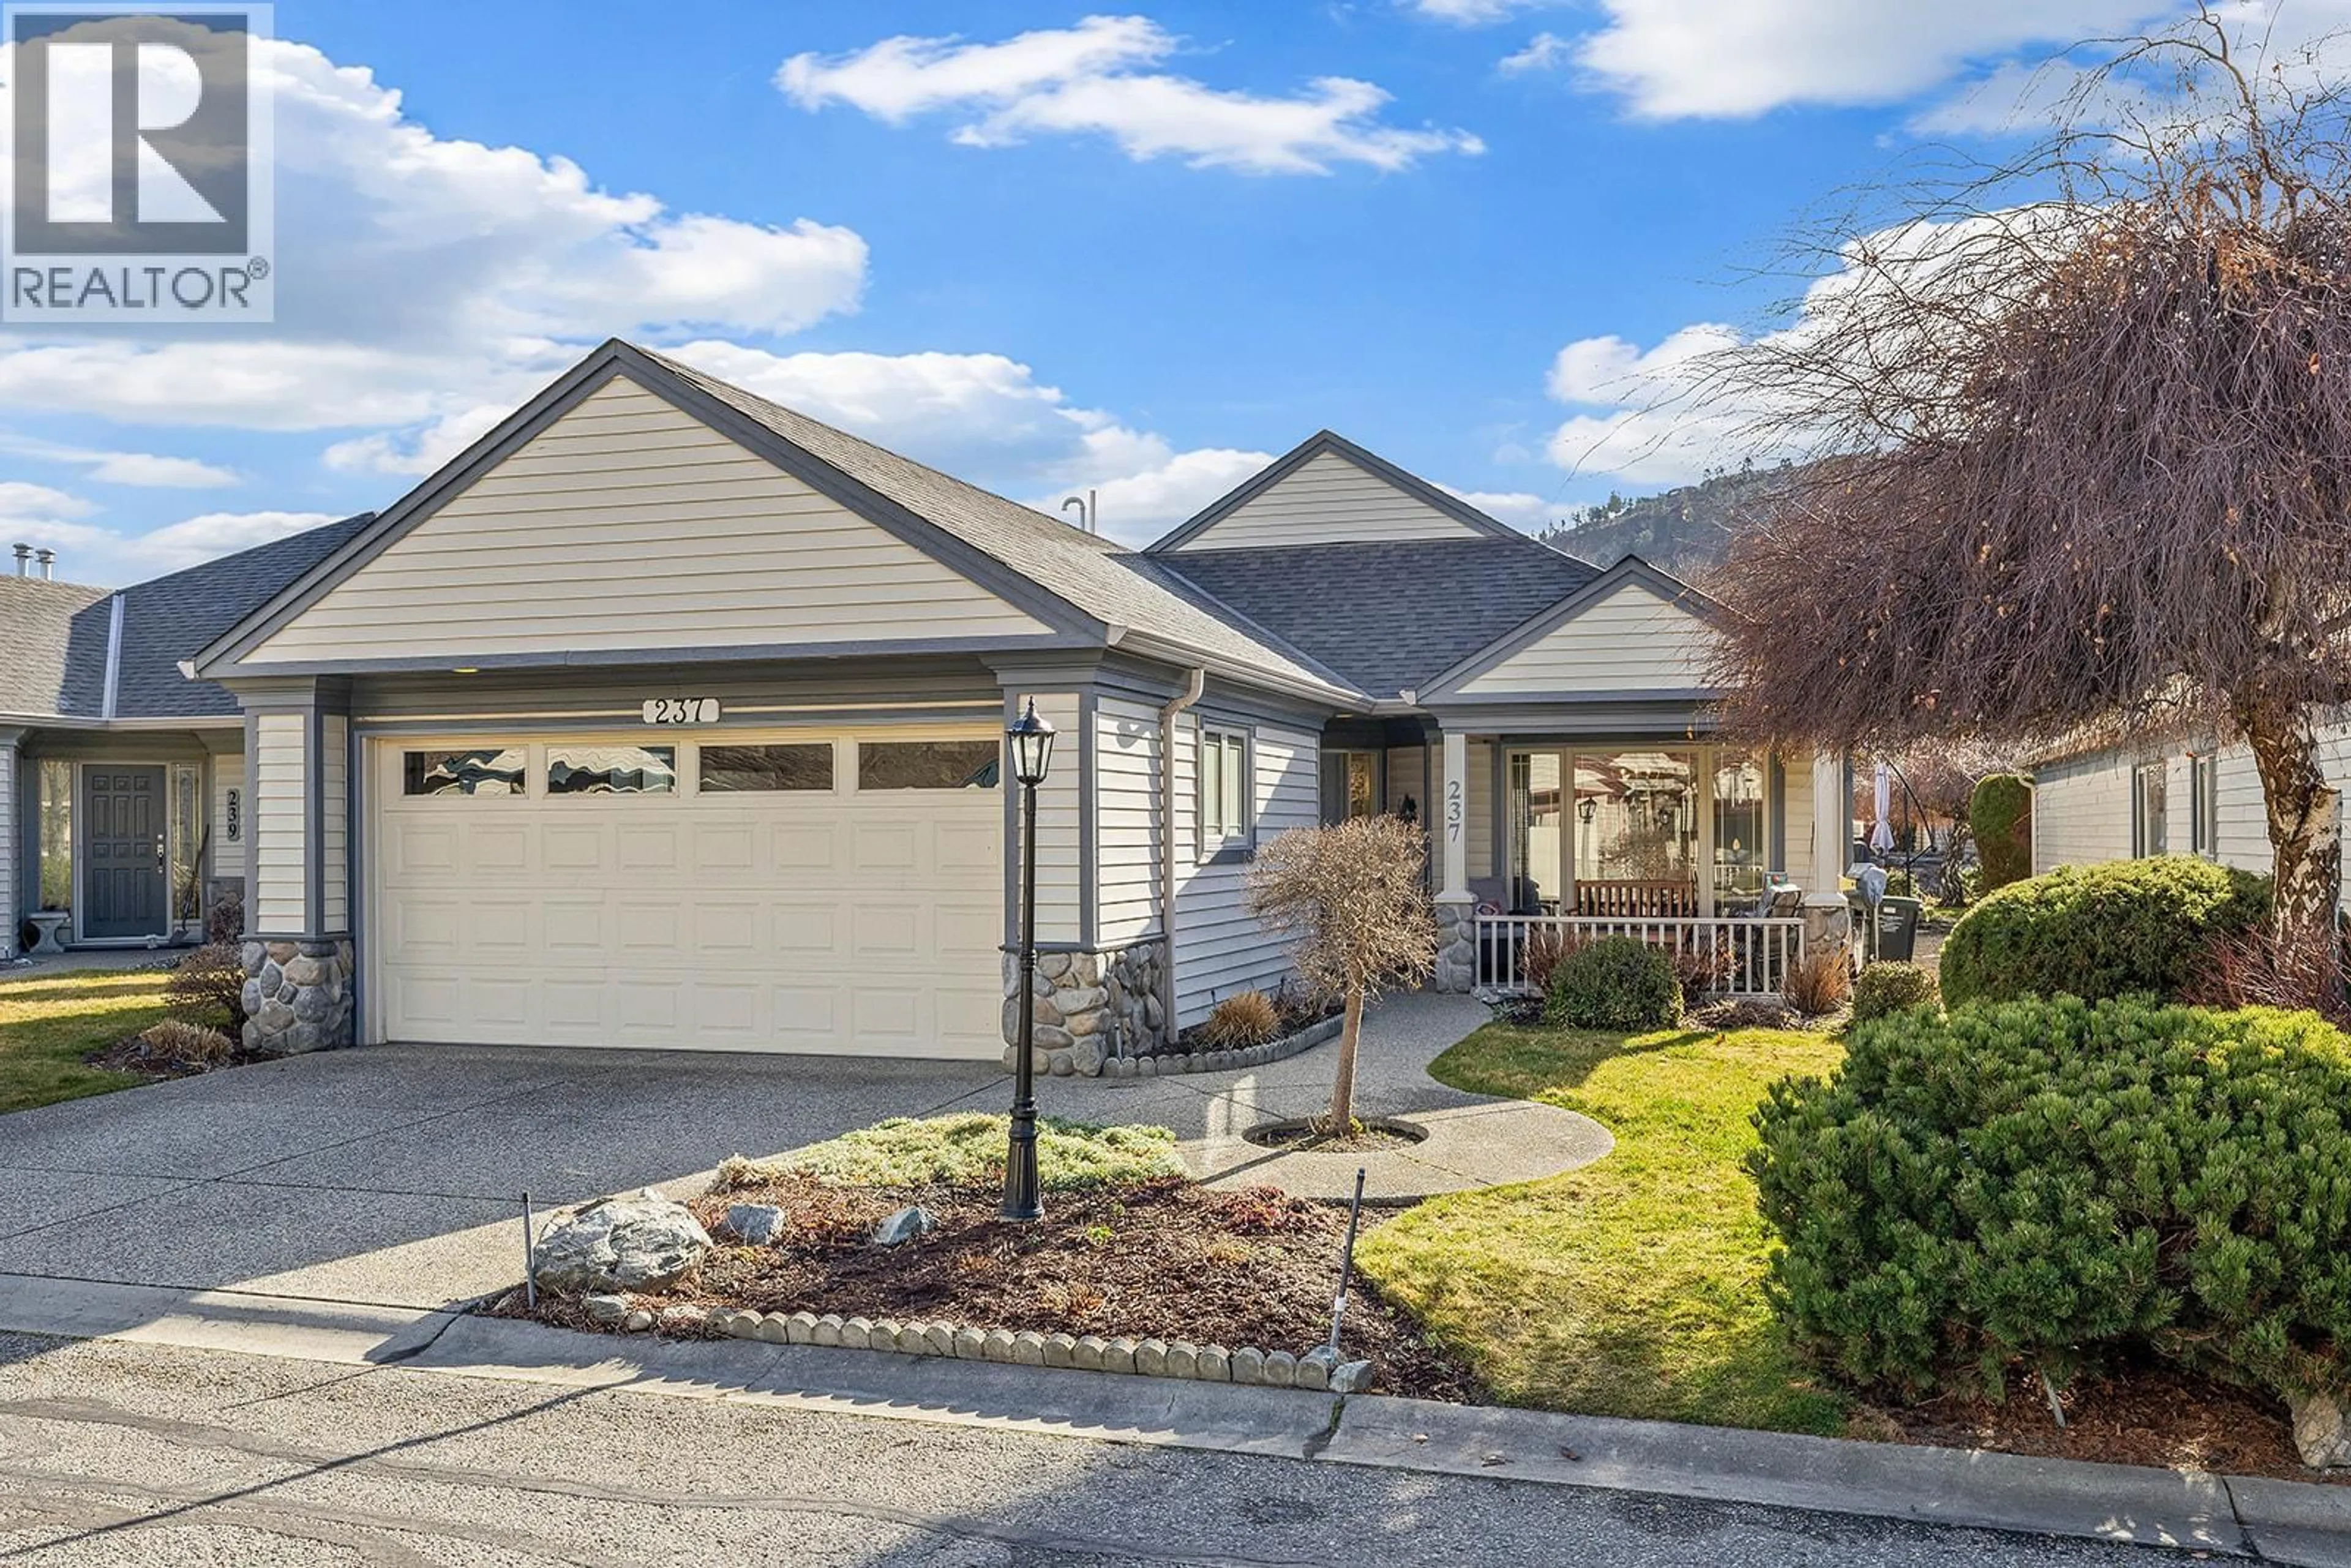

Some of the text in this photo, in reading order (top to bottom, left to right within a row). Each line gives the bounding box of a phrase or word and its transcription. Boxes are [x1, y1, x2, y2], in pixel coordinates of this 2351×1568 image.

[655, 697, 705, 724] 237
[228, 791, 237, 837] 239
[1448, 780, 1461, 842] 237
